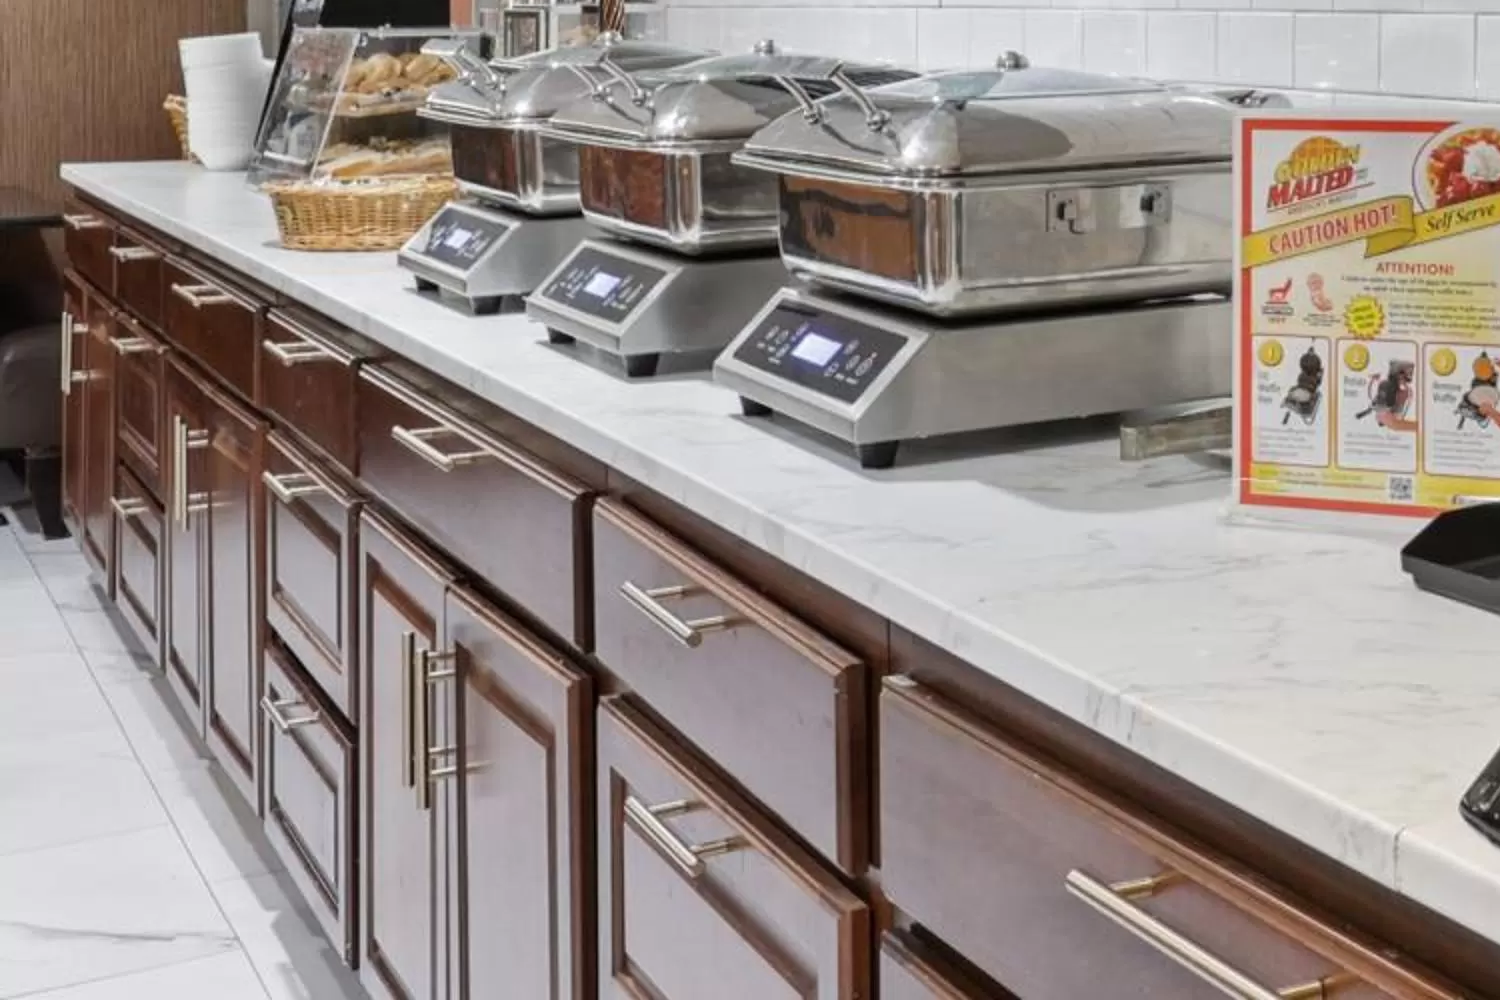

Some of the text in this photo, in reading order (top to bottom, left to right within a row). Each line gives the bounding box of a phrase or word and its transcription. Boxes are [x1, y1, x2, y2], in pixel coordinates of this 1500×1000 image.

[1267, 167, 1354, 208] MALTED
[1268, 219, 1350, 254] CAUTION
[1353, 203, 1398, 239] HOT!
[1425, 203, 1496, 233] Self Serve
[1376, 262, 1455, 276] ATTENTION!
